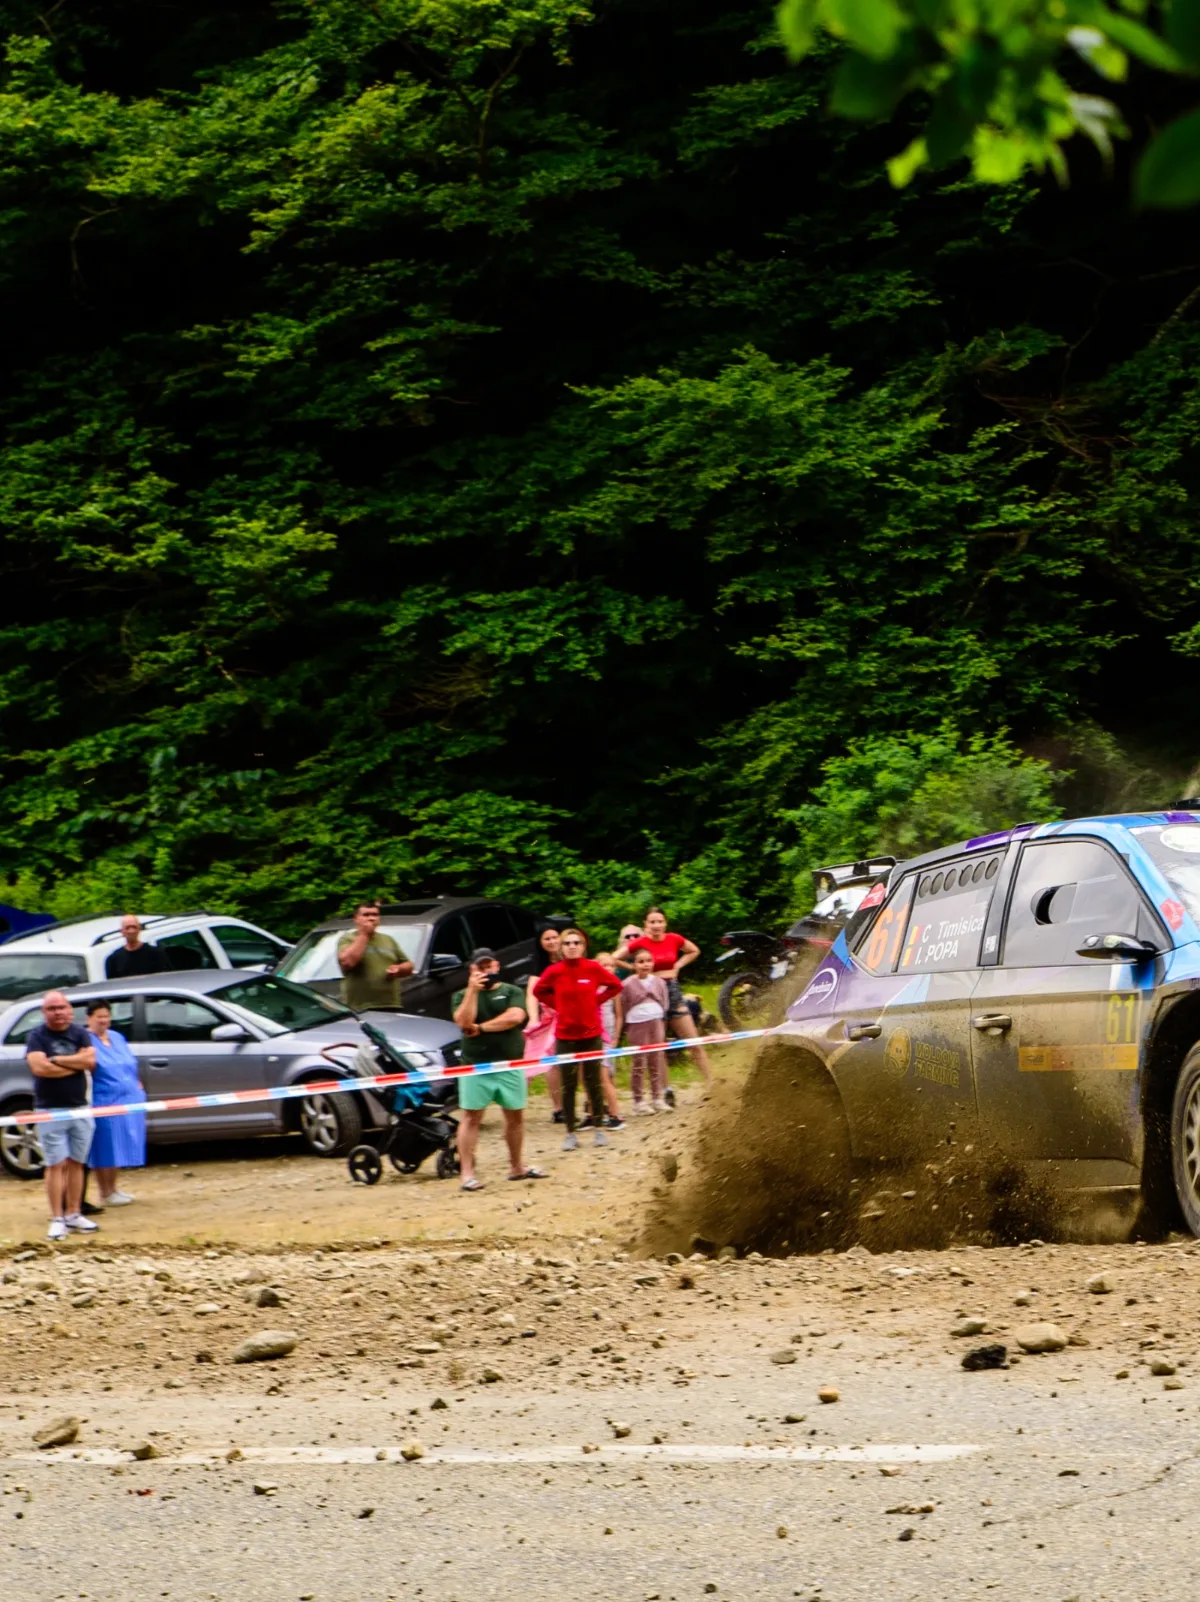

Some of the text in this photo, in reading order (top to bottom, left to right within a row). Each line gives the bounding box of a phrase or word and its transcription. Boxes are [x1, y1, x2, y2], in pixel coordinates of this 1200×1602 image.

[866, 903, 909, 969] 61
[925, 940, 958, 962] POPA
[1105, 994, 1135, 1044] 61
[915, 1041, 960, 1070] MOLDOVA
[914, 1060, 960, 1088] FARMING
